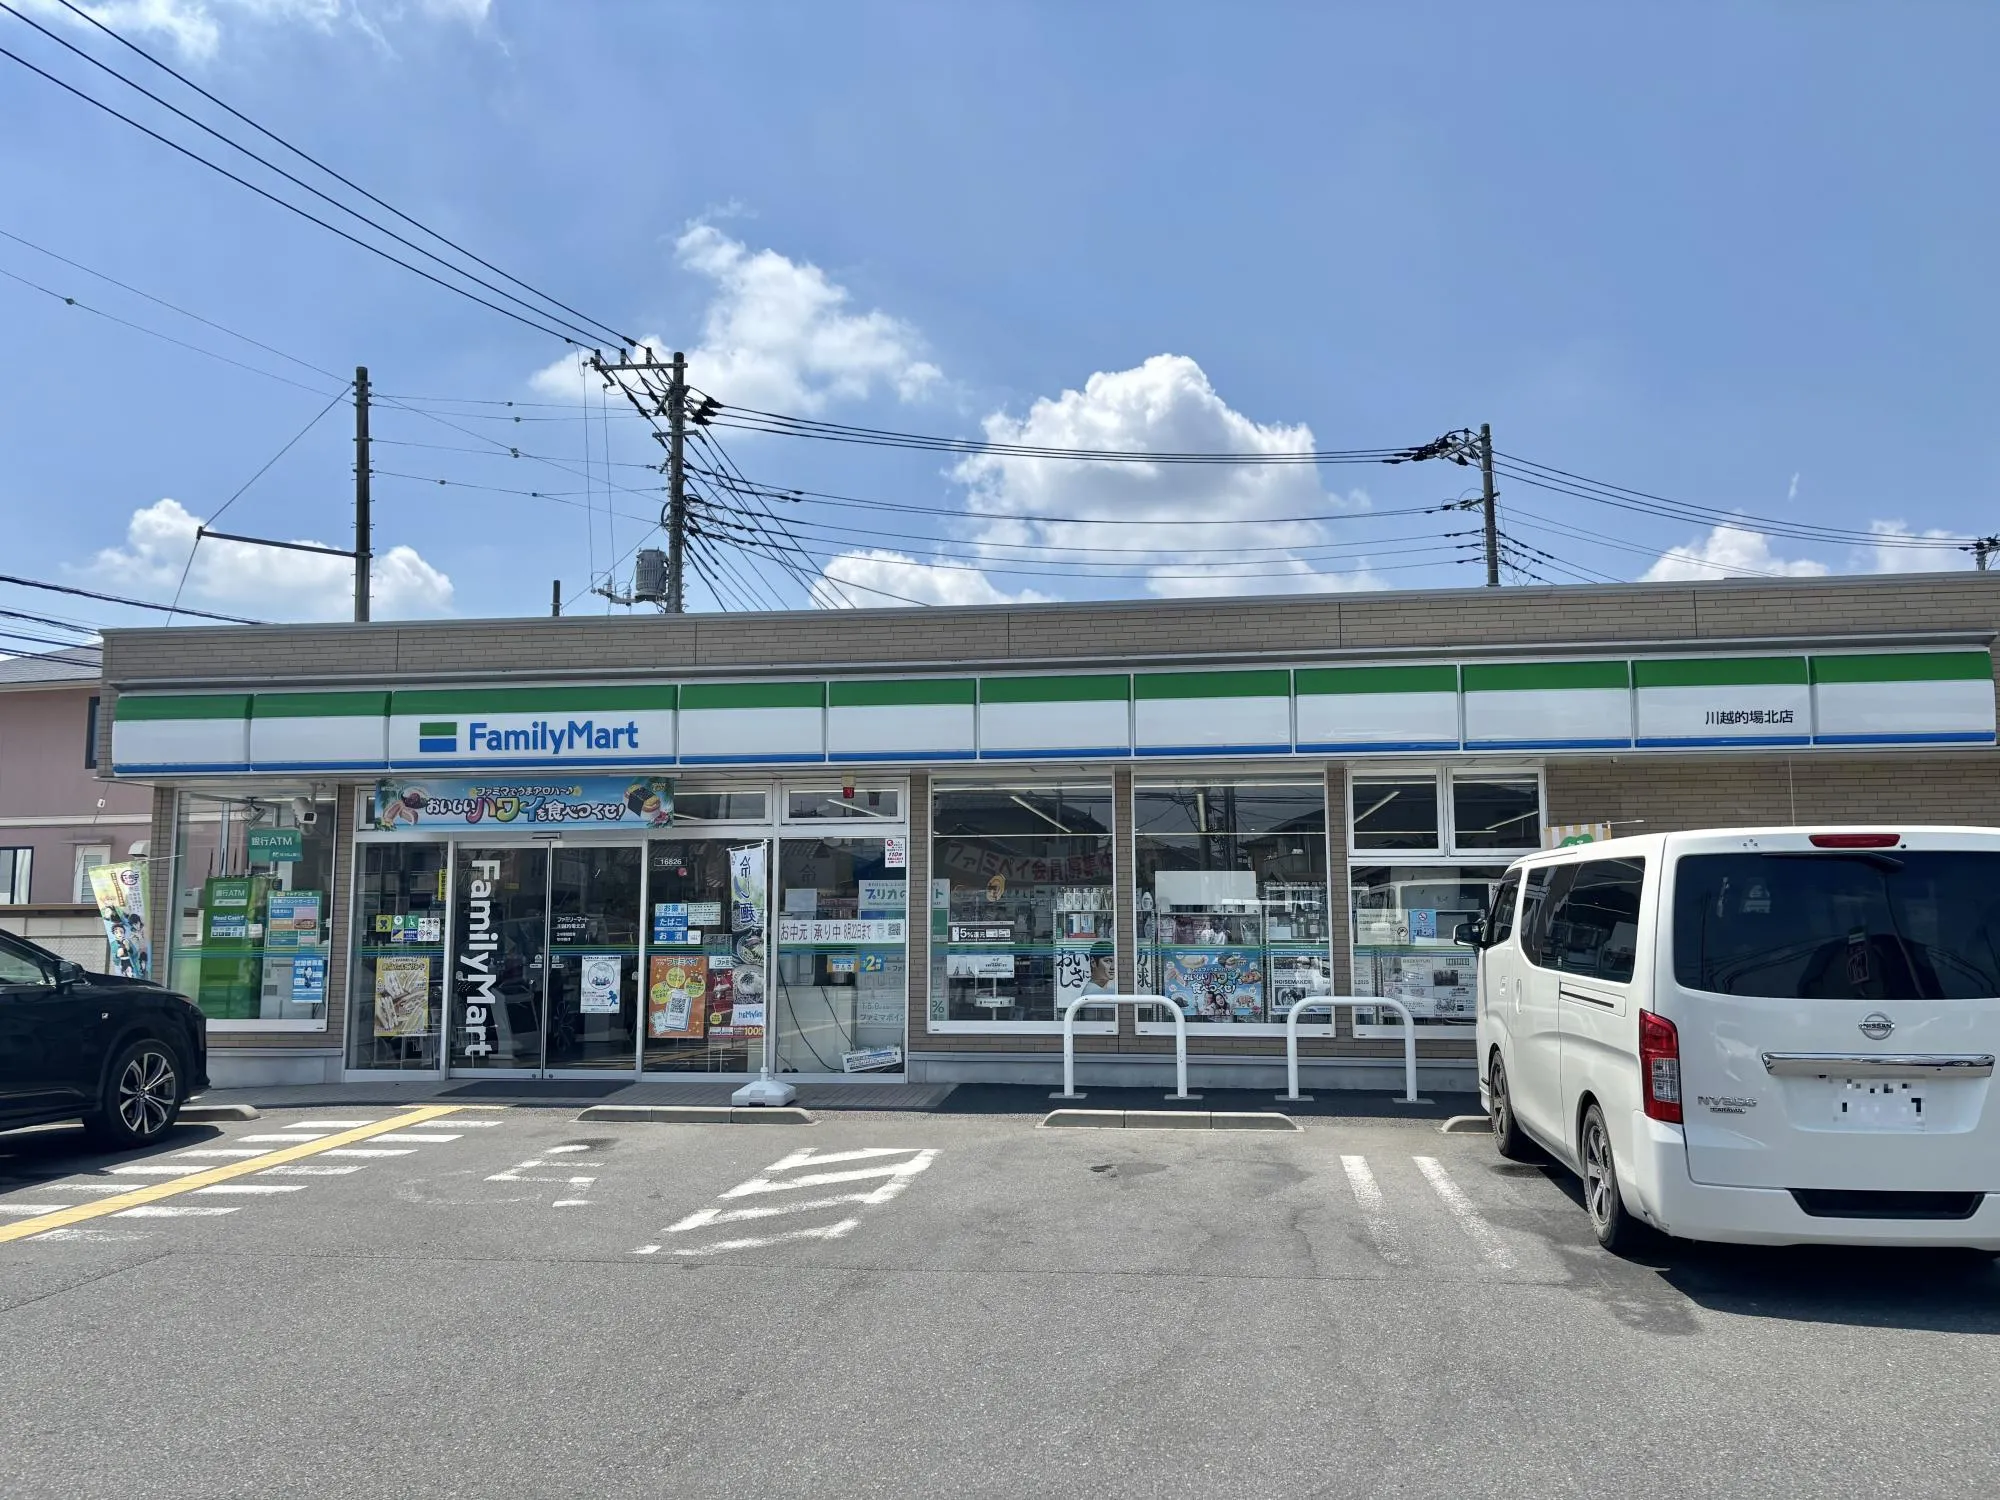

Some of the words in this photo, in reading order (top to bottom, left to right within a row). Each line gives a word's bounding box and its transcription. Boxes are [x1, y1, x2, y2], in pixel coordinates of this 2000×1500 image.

[1705, 709, 1794, 725] 川越的場北店
[469, 720, 639, 755] FamilyMart
[251, 837, 293, 846] 銀行ATM
[659, 918, 683, 926] たばこ
[780, 922, 808, 941] お中元
[460, 859, 501, 1056] FamilyMart
